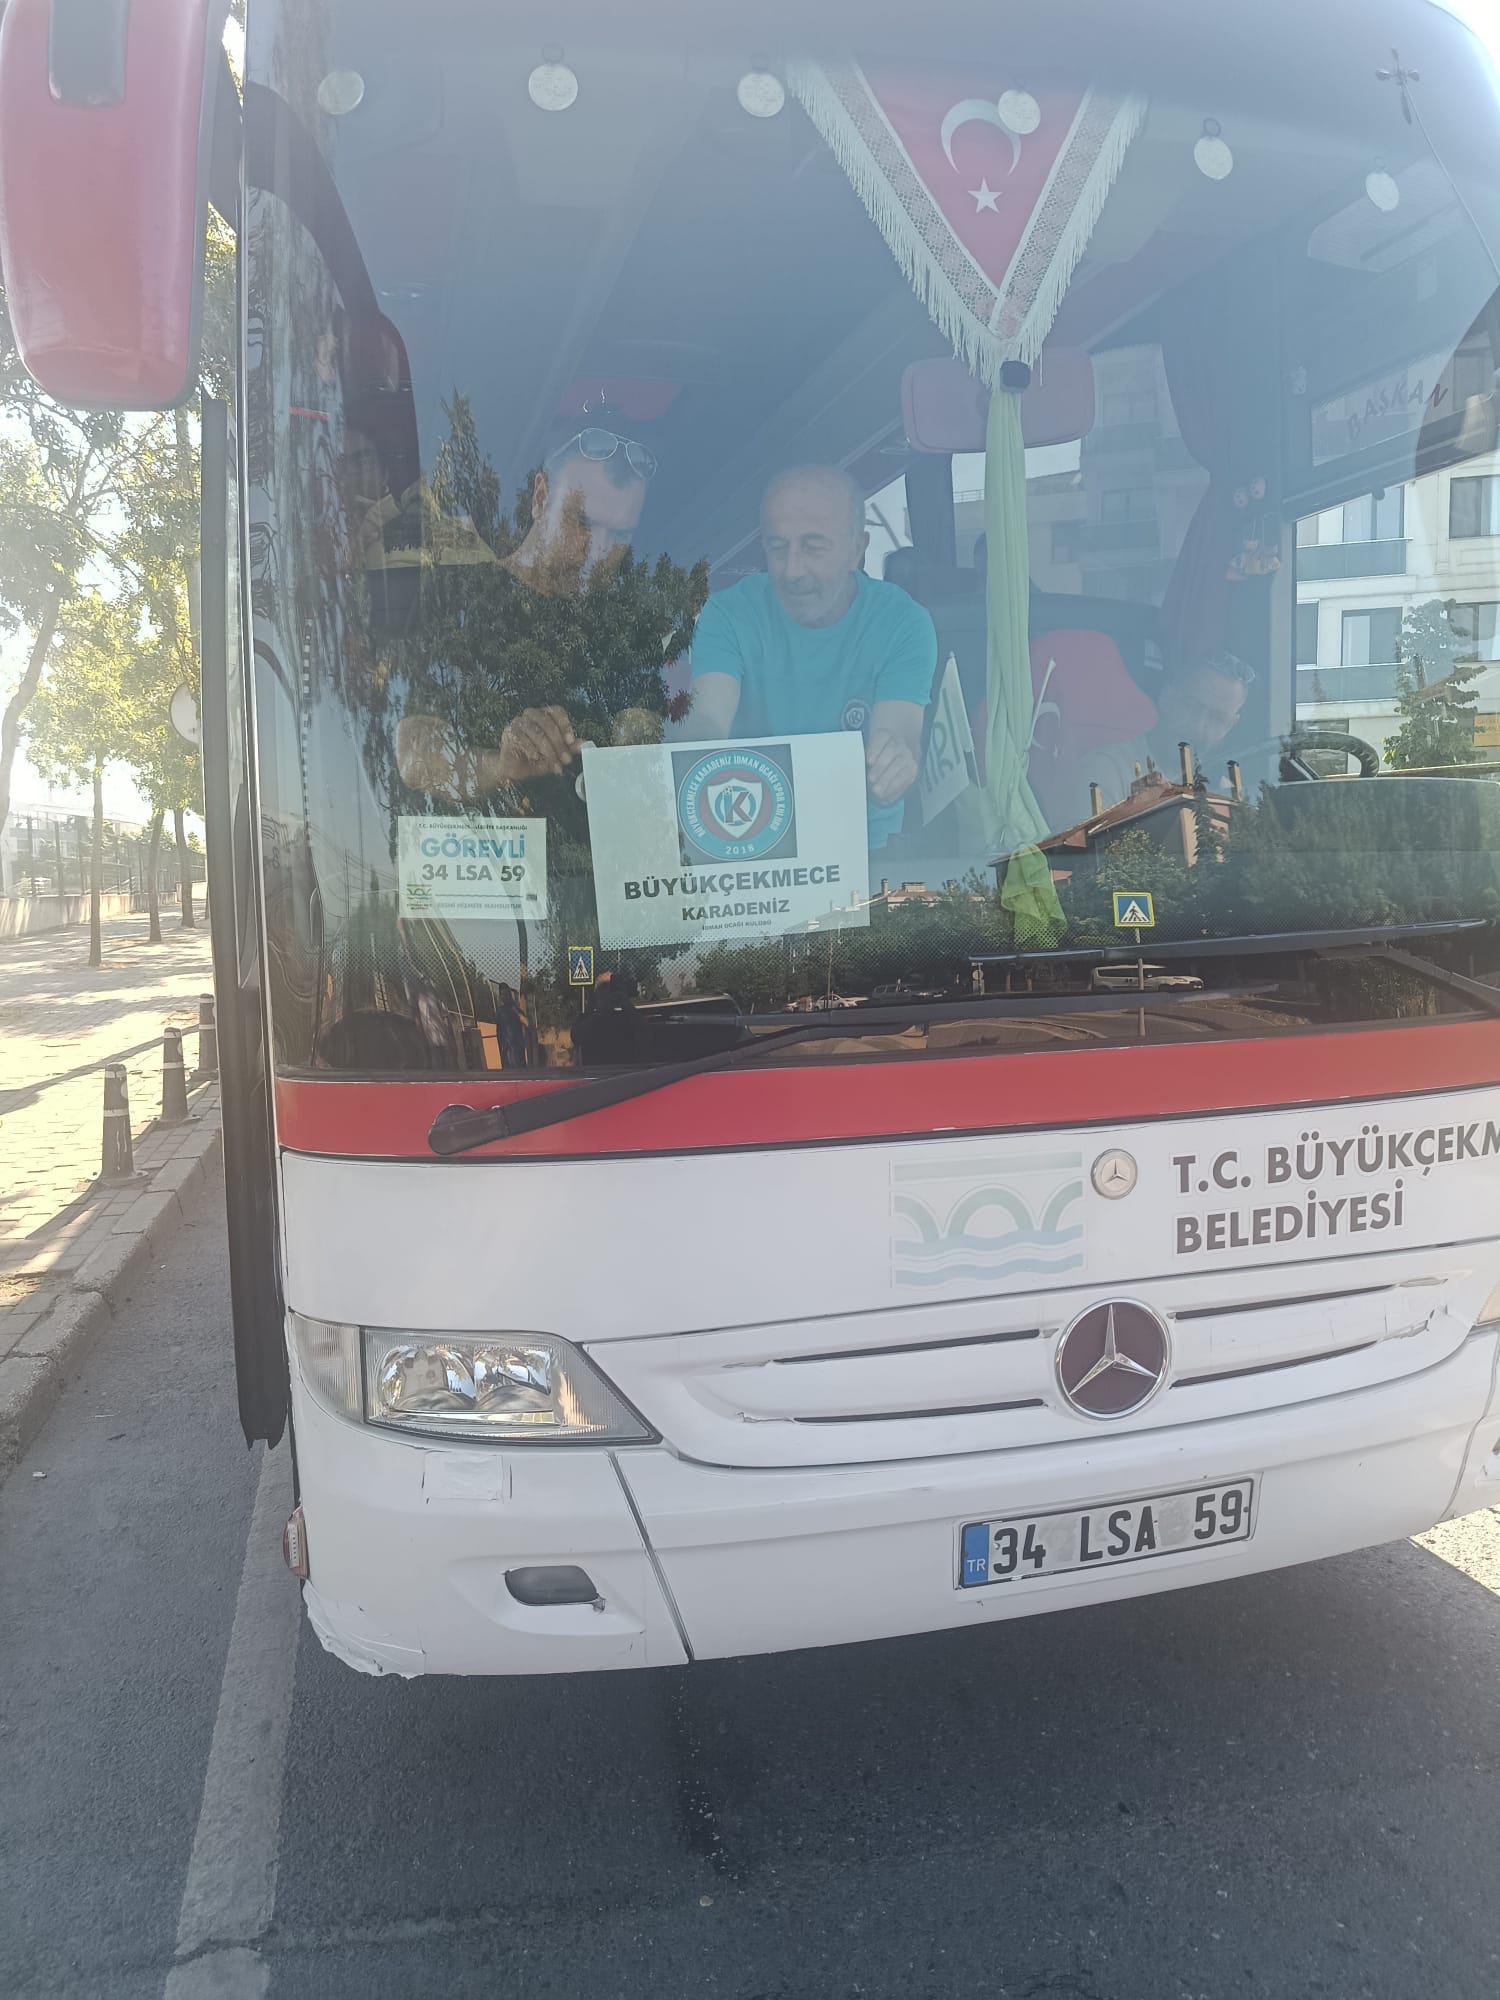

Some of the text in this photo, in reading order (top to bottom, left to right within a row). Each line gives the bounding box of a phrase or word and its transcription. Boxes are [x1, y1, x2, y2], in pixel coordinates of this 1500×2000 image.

[695, 756, 731, 782] KARADENİZ
[733, 754, 760, 769] İDMAN
[421, 833, 527, 859] GÖREVLİ
[422, 864, 526, 882] 34 LSA 59
[624, 864, 841, 900] BÜYÜKÇEKMECE
[682, 897, 790, 921] KARADENİZ
[1173, 1151, 1252, 1193] T.C.
[1176, 1178, 1403, 1254] BELEDİYESİ
[993, 1489, 1243, 1575] 34 LSA 59
[967, 1558, 986, 1573] TR
